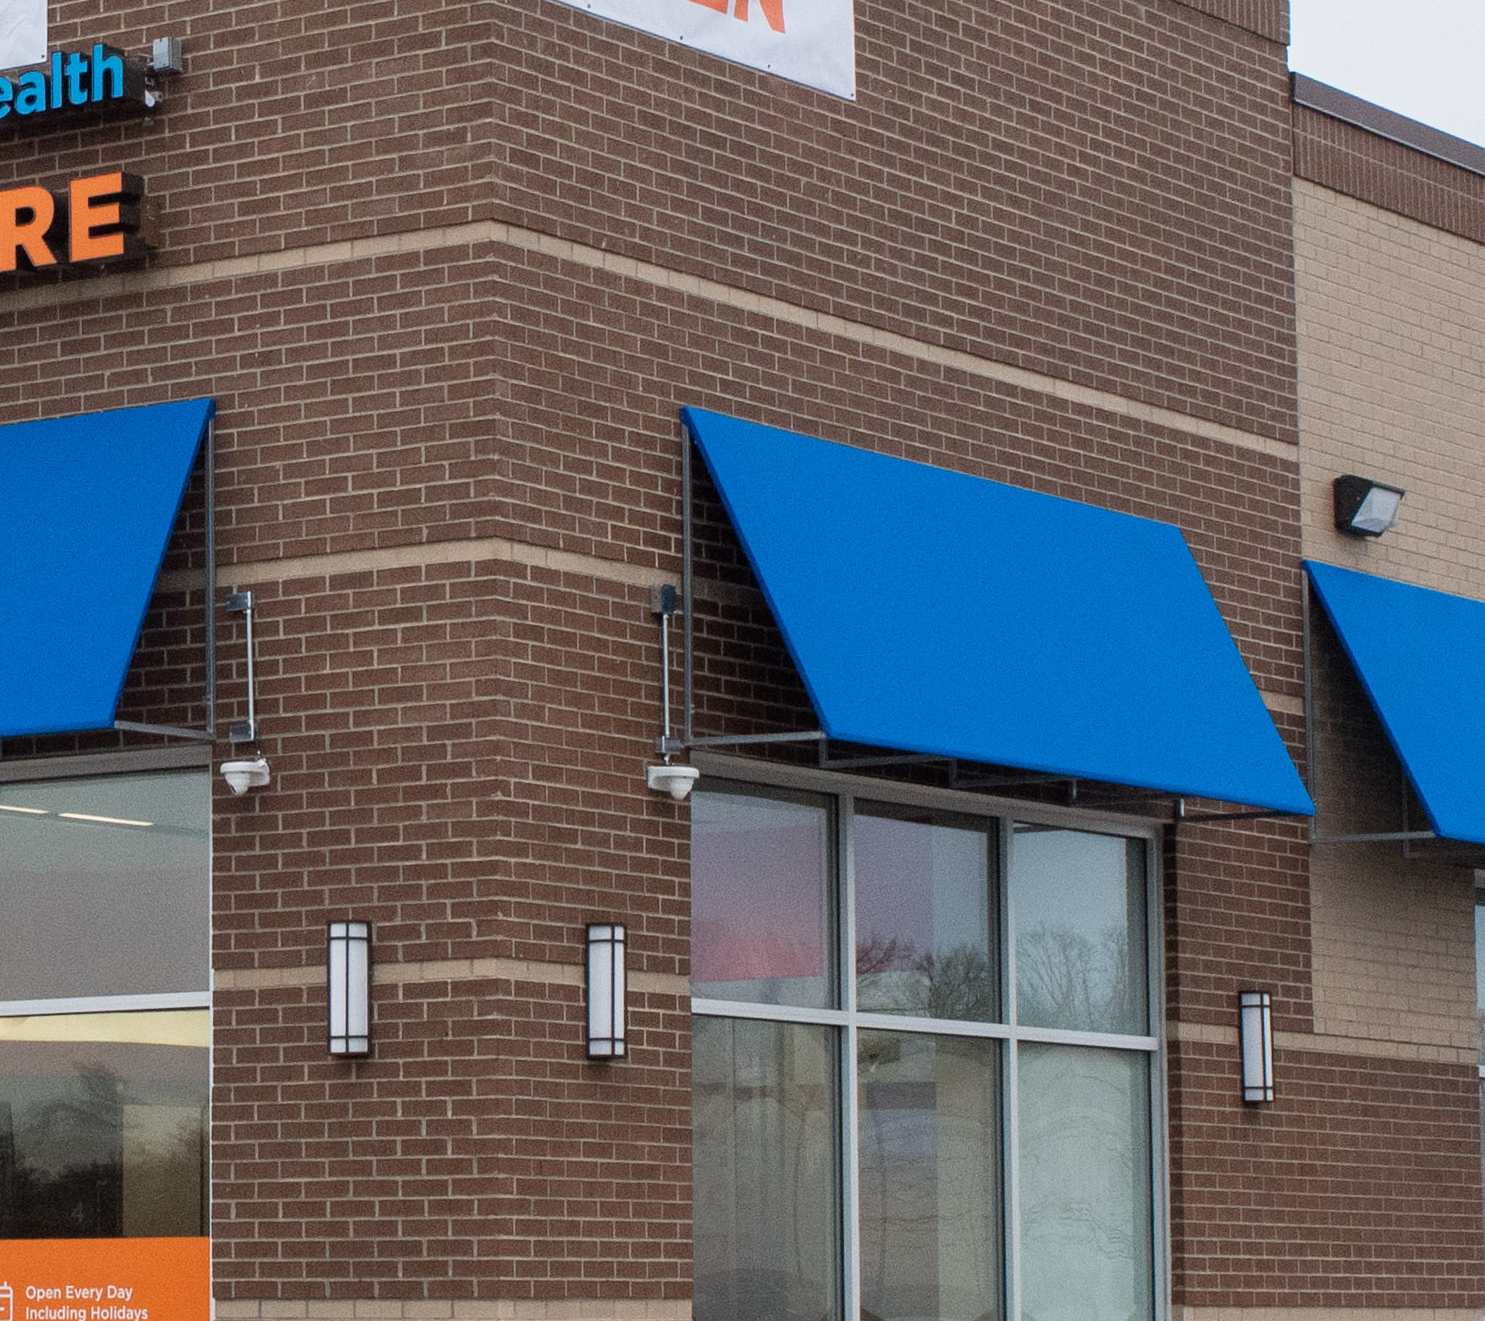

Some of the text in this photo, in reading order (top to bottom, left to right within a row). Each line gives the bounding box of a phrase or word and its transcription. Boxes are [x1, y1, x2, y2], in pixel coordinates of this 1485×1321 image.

[25, 1285, 133, 1301] Open Every Day
[25, 1306, 148, 1321] Including Holidays
